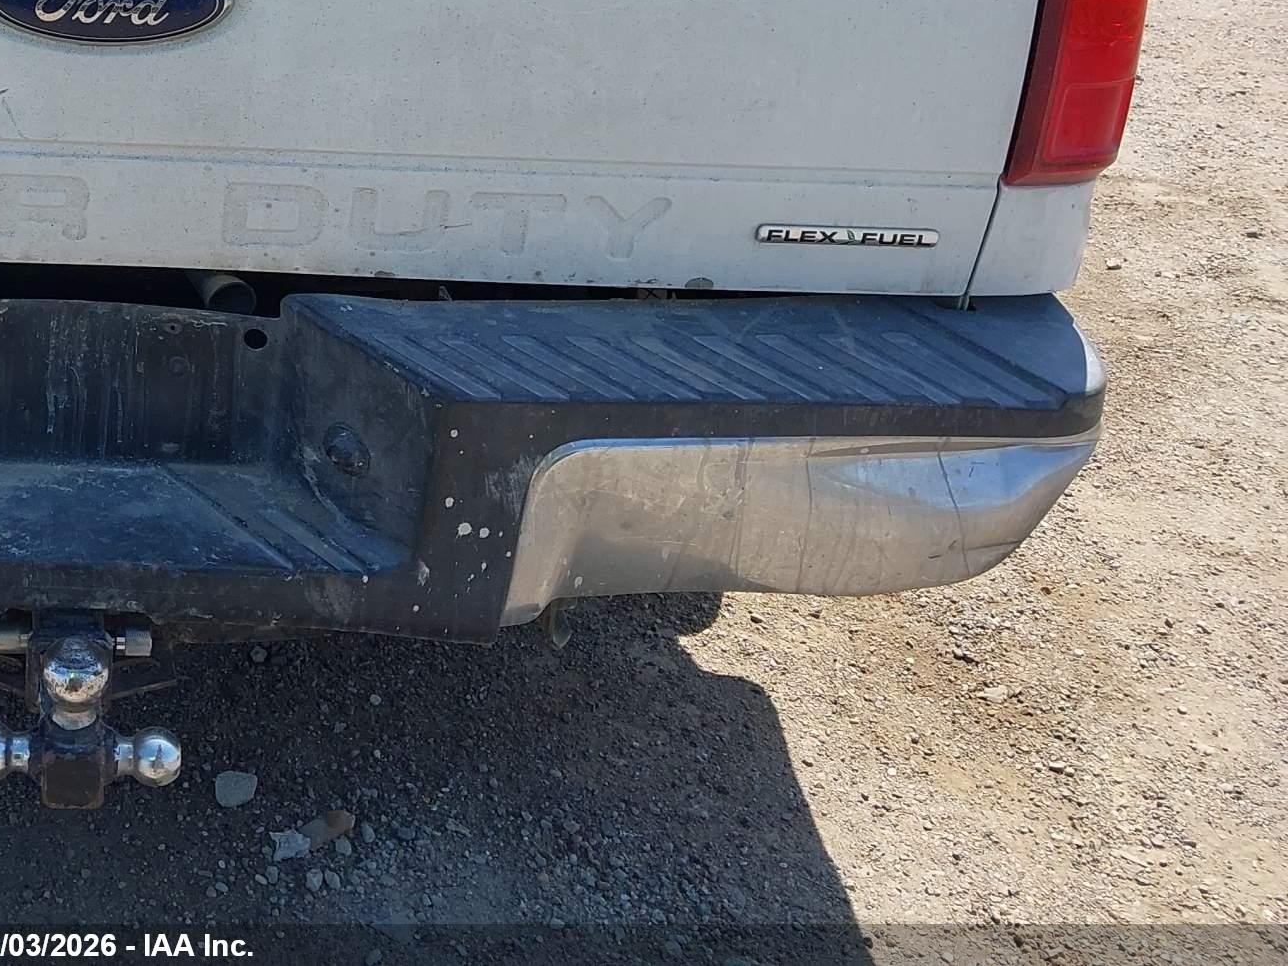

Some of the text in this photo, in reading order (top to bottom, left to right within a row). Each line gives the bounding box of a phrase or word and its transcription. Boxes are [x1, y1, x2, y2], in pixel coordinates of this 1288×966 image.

[222, 181, 672, 260] DUTY
[766, 229, 937, 247] FLEX FUEL
